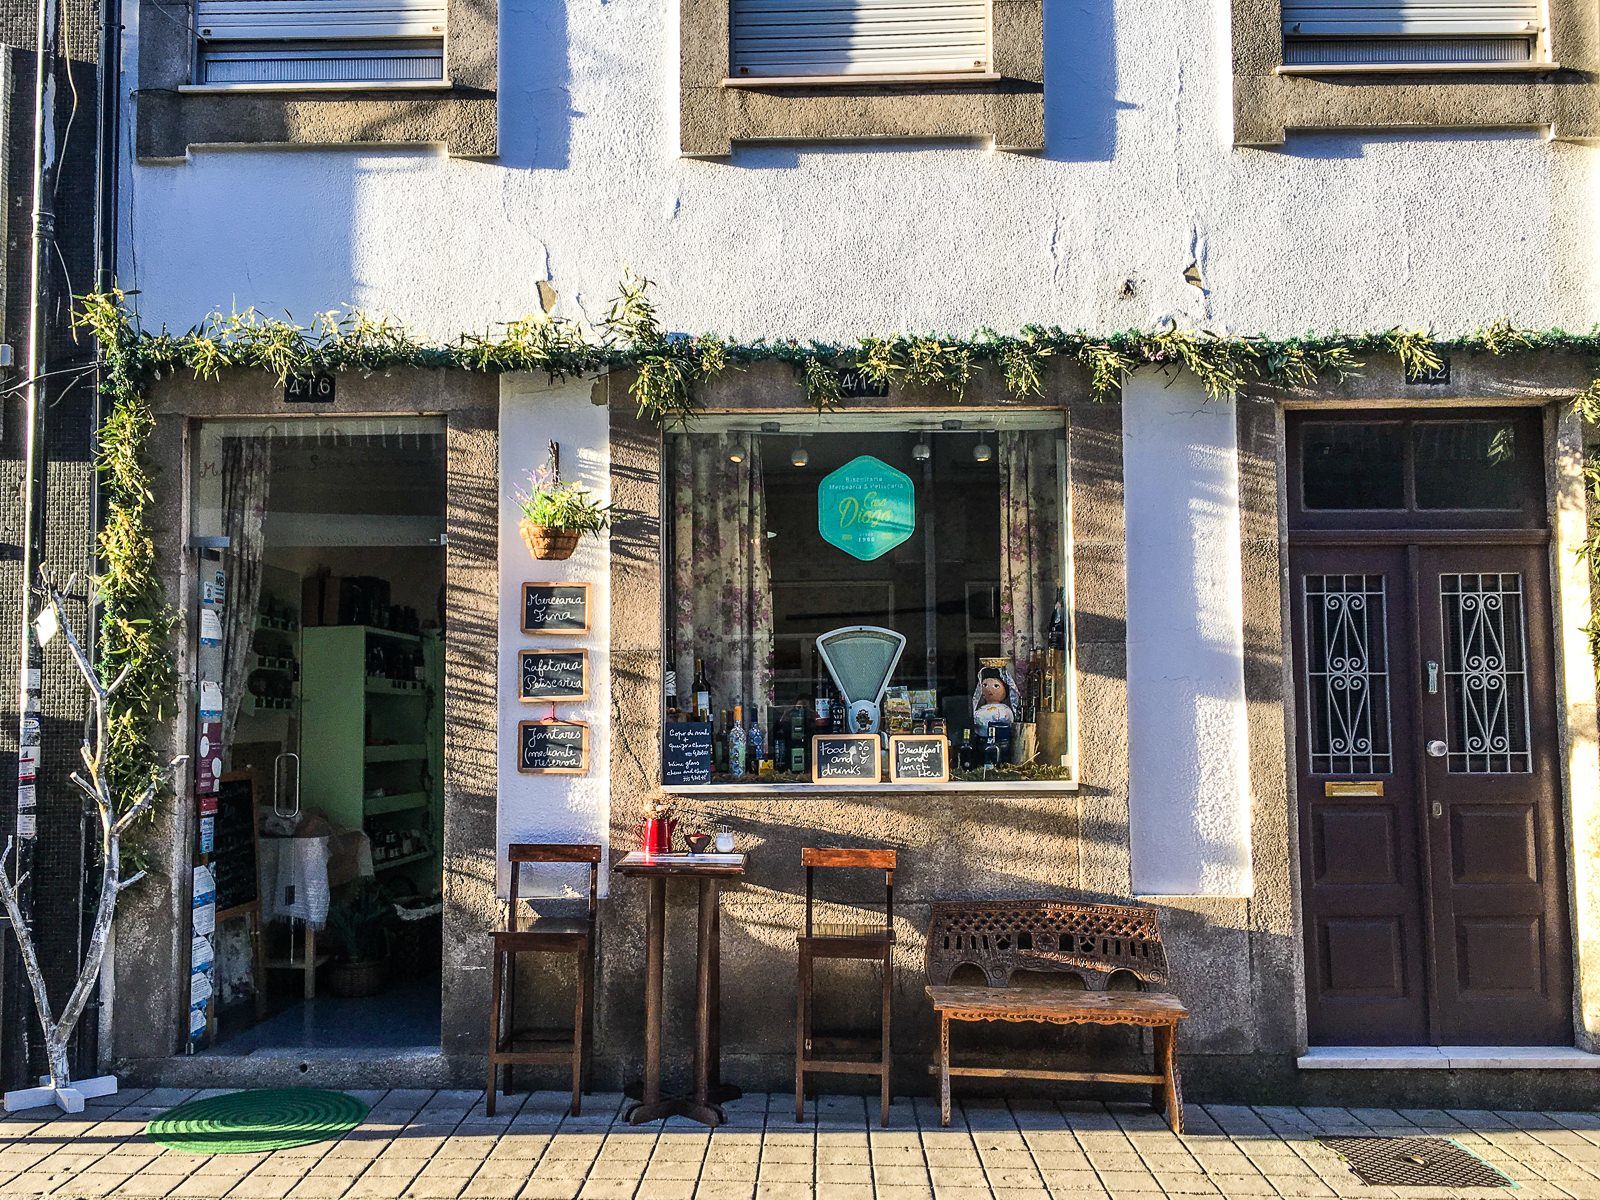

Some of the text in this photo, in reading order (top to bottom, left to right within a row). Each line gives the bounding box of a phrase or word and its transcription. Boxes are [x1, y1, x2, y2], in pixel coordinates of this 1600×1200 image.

[289, 377, 330, 395] 416
[838, 496, 892, 528] Diogo
[527, 593, 585, 605] Mercearia
[533, 606, 576, 622] Fina
[524, 658, 582, 677] Cafetaria
[523, 674, 583, 690] Petiscaria
[528, 727, 581, 748] Jantares
[830, 750, 854, 765] and
[897, 741, 942, 758] Breakfast
[903, 753, 928, 763] and
[821, 762, 861, 777] drinks
